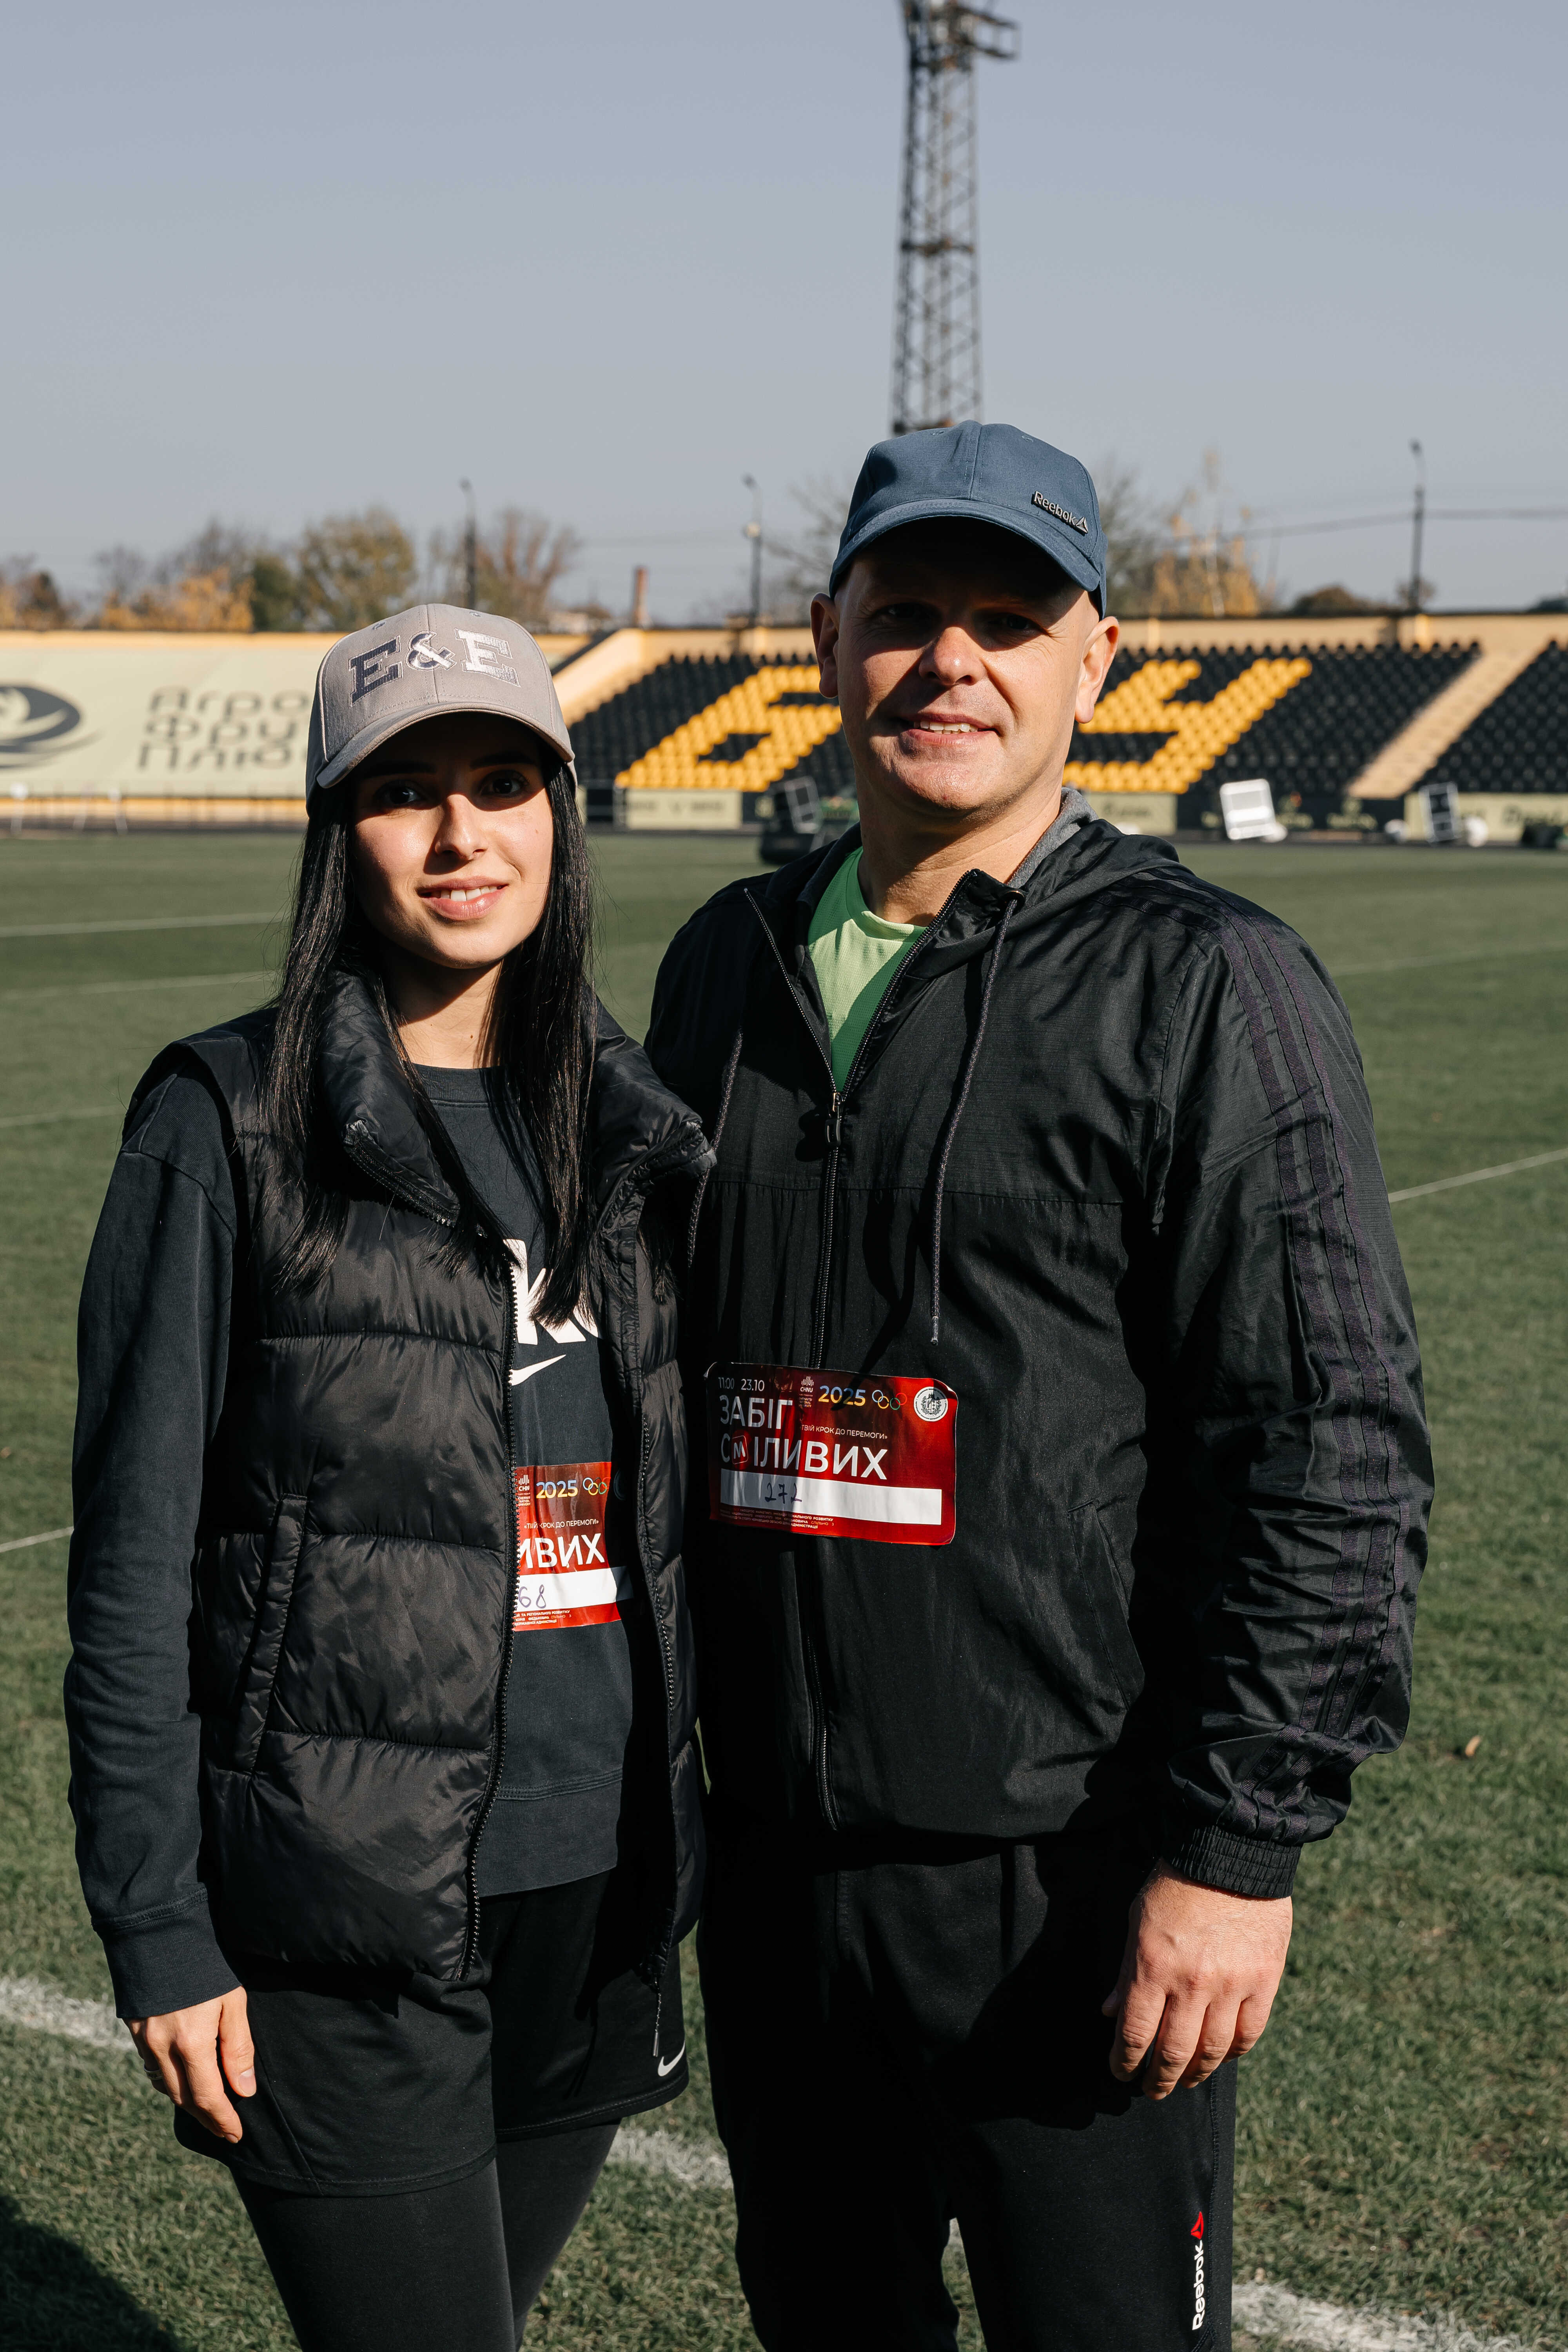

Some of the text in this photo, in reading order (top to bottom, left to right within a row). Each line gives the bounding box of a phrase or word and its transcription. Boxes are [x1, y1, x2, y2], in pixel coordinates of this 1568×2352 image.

[1034, 490, 1076, 526] Reebok
[139, 742, 307, 772] Плю
[718, 1377, 764, 1392] 11:00 23.10
[818, 1385, 866, 1406] 2025
[719, 1394, 793, 1430] ЗАБІГ
[816, 1426, 835, 1434] КРОК
[846, 1429, 888, 1440] ПЕРЕМОГИ»
[536, 1480, 579, 1499] 2025
[566, 1519, 599, 1527] ПЕРЕМОГИ»
[517, 1533, 605, 1568] ИВИХ
[516, 1584, 546, 1609] 68
[1192, 2239, 1206, 2330] Reebok
